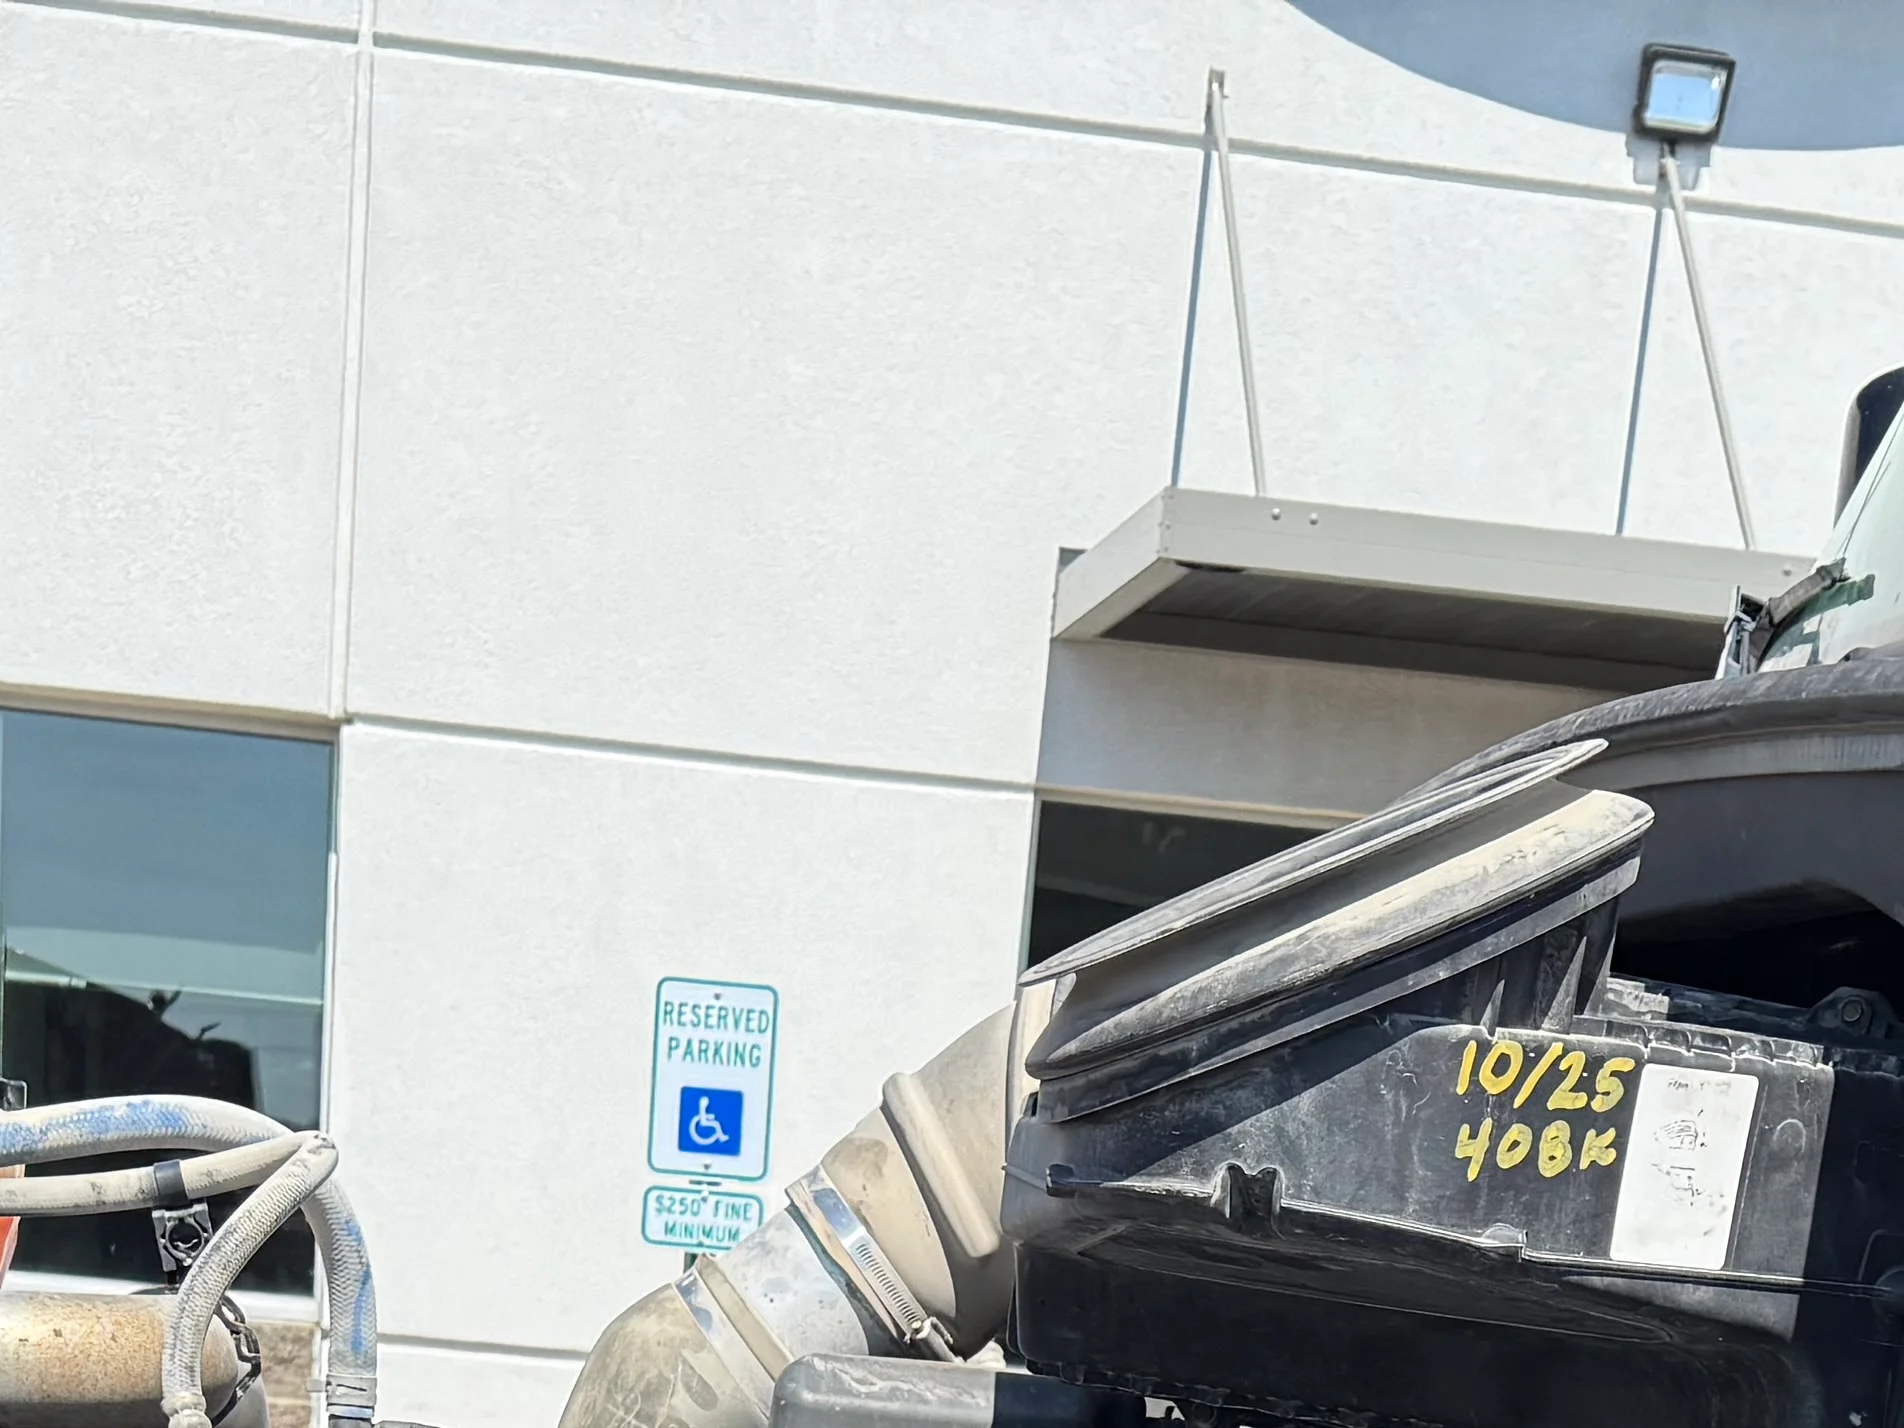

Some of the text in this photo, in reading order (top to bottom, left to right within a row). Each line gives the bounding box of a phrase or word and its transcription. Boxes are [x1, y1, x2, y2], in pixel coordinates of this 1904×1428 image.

[662, 1000, 770, 1034] RESERVED
[666, 1037, 762, 1068] PARKING
[1455, 1038, 1636, 1113] 10/25
[1454, 1117, 1617, 1182] 408K
[654, 1194, 753, 1221] $250 FINE
[663, 1219, 741, 1243] MINIMUM
